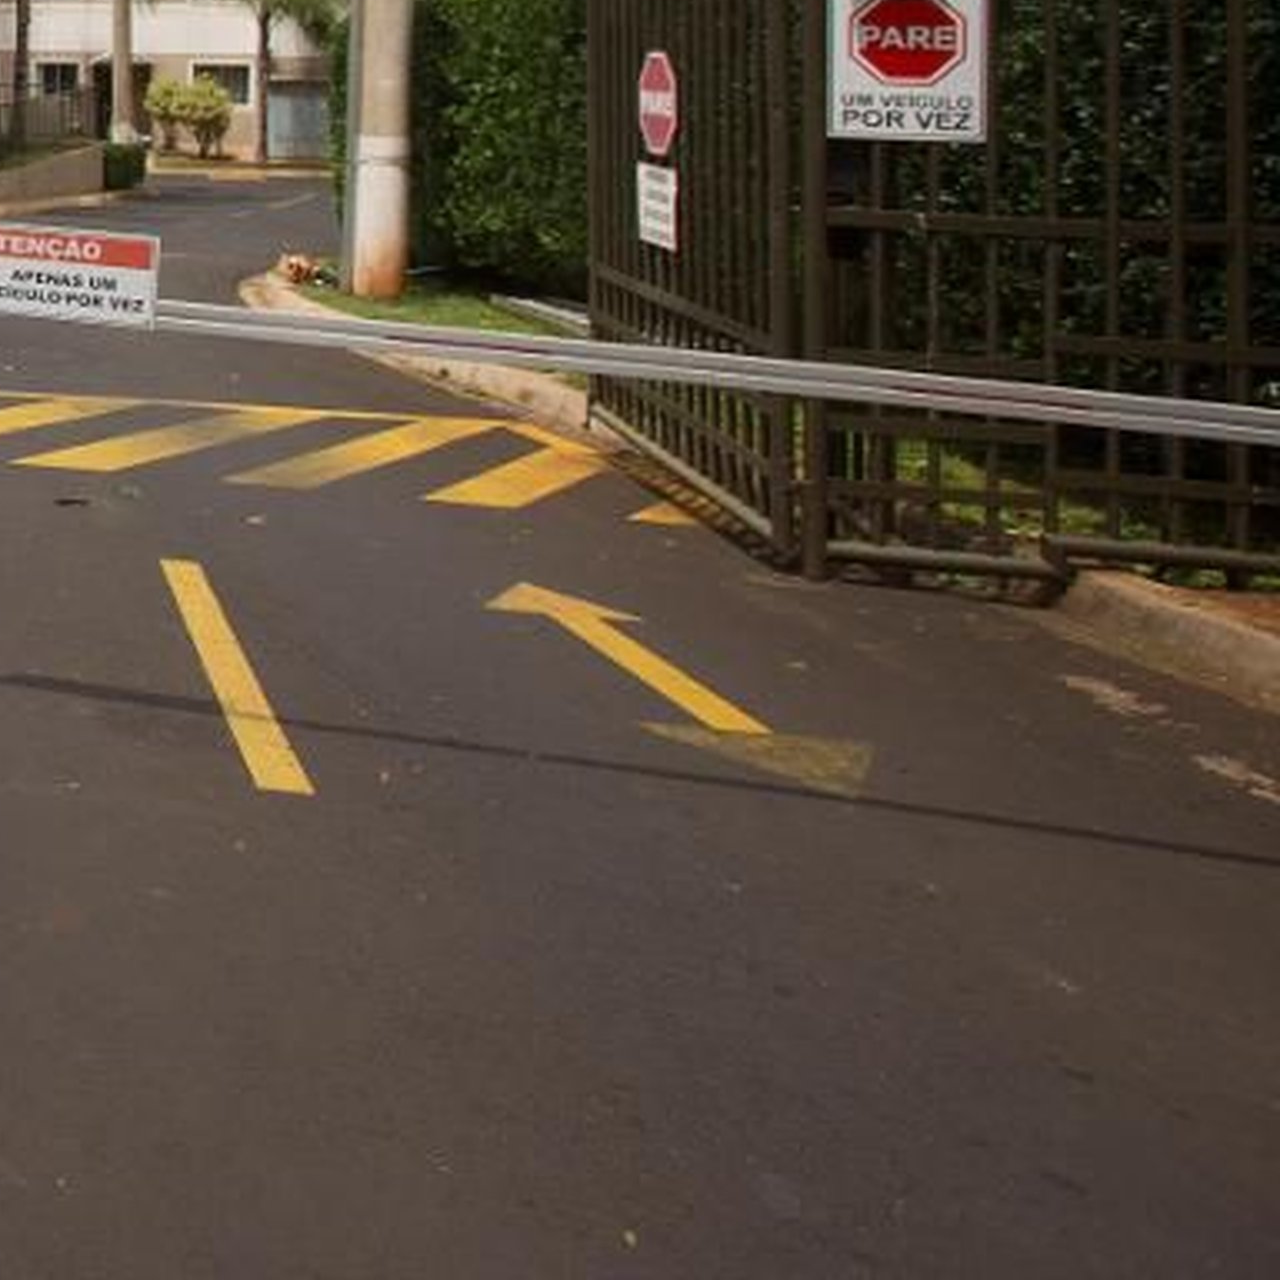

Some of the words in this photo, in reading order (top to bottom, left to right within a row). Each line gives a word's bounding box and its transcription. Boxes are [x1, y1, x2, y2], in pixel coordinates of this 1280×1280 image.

[858, 24, 956, 52] PARE
[840, 93, 873, 107] UM
[842, 109, 905, 129] POR
[915, 112, 971, 131] VEZ
[10, 269, 83, 287] APENAS
[89, 276, 118, 291] UM
[66, 292, 104, 308] POR
[109, 296, 145, 314] VEZ
